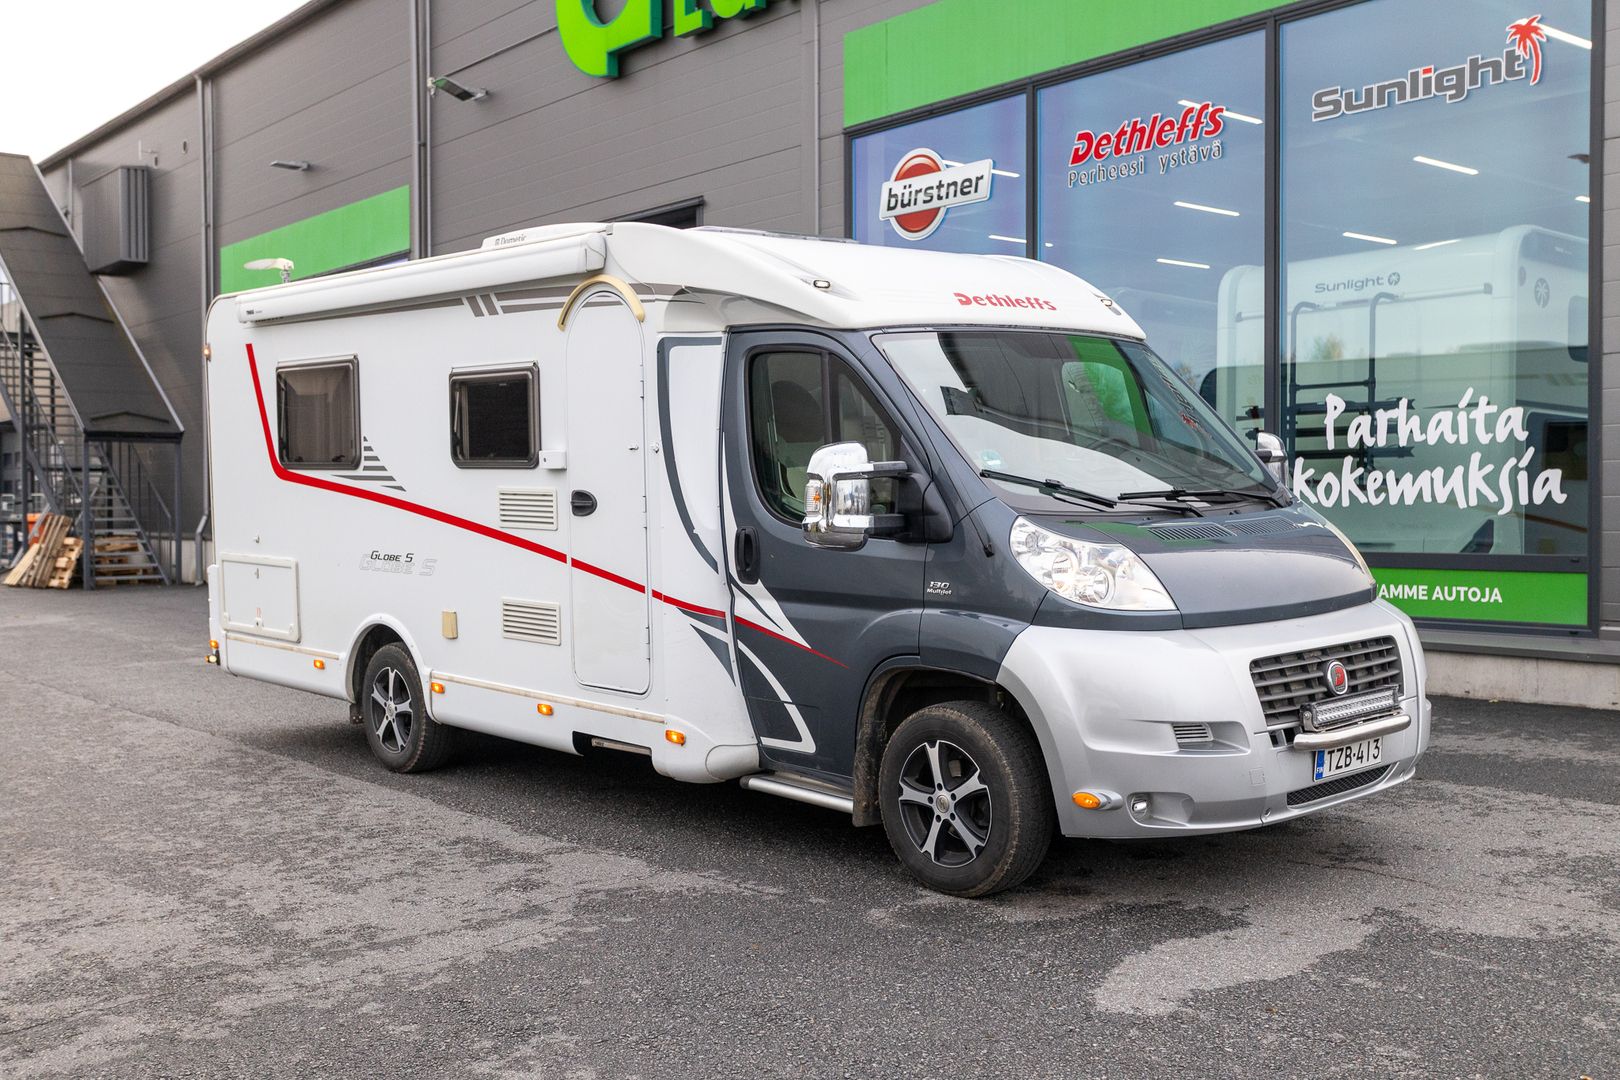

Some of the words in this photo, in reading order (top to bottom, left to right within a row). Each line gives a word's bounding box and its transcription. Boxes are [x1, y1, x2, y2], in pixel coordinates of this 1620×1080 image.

[1312, 47, 1526, 121] Sunlight
[1069, 102, 1225, 166] Dethleffs
[1068, 155, 1145, 188] Perheesi
[1158, 139, 1222, 175] ystävä
[886, 174, 984, 212] bürstner
[953, 293, 1057, 311] Dethleffs
[1324, 386, 1529, 450] Parhaita
[1377, 584, 1428, 600] AMME
[1431, 586, 1503, 603] AUTOJA
[1327, 738, 1380, 772] TZB-413
